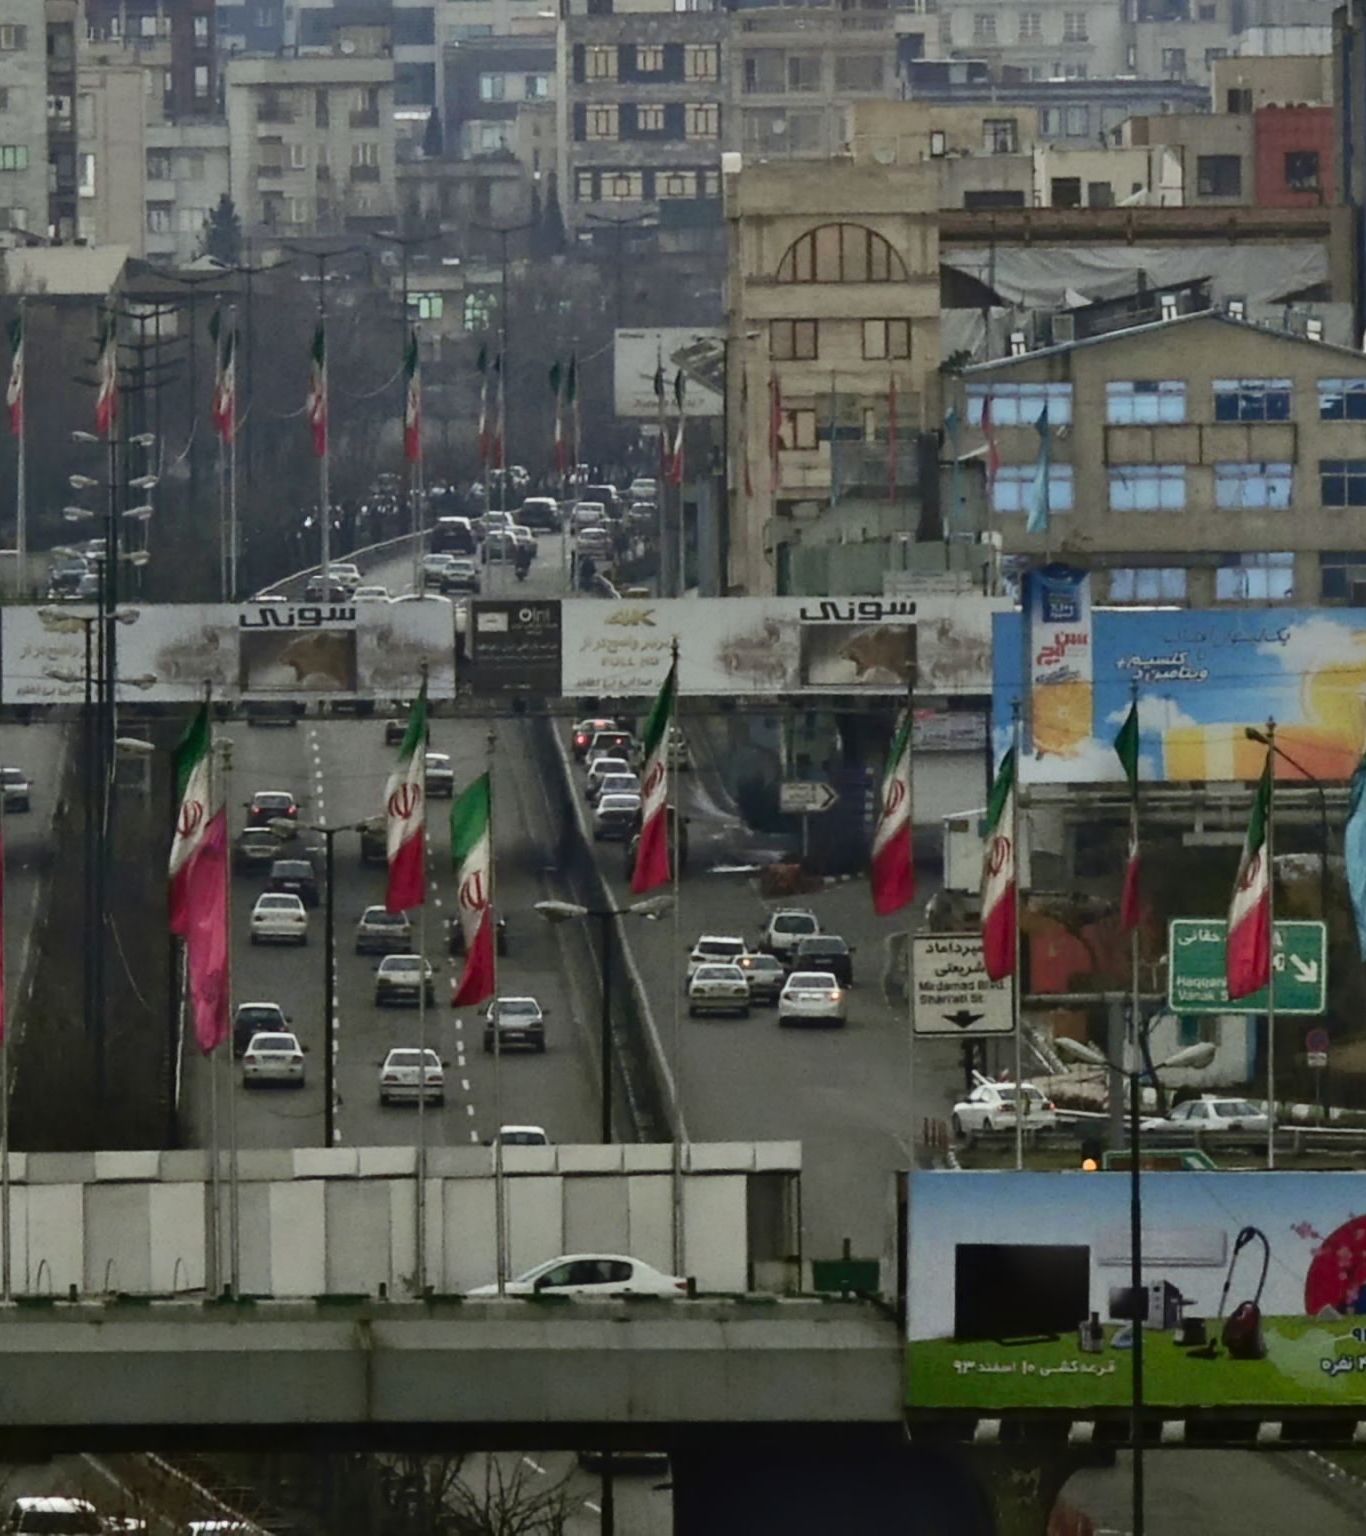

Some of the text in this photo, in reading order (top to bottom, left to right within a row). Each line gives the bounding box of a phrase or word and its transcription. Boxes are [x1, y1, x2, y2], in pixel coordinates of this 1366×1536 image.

[239, 606, 357, 628] سونی
[800, 601, 917, 621] سونی
[978, 1360, 1017, 1374] اسفند
[1321, 1357, 1354, 1376] نفره
